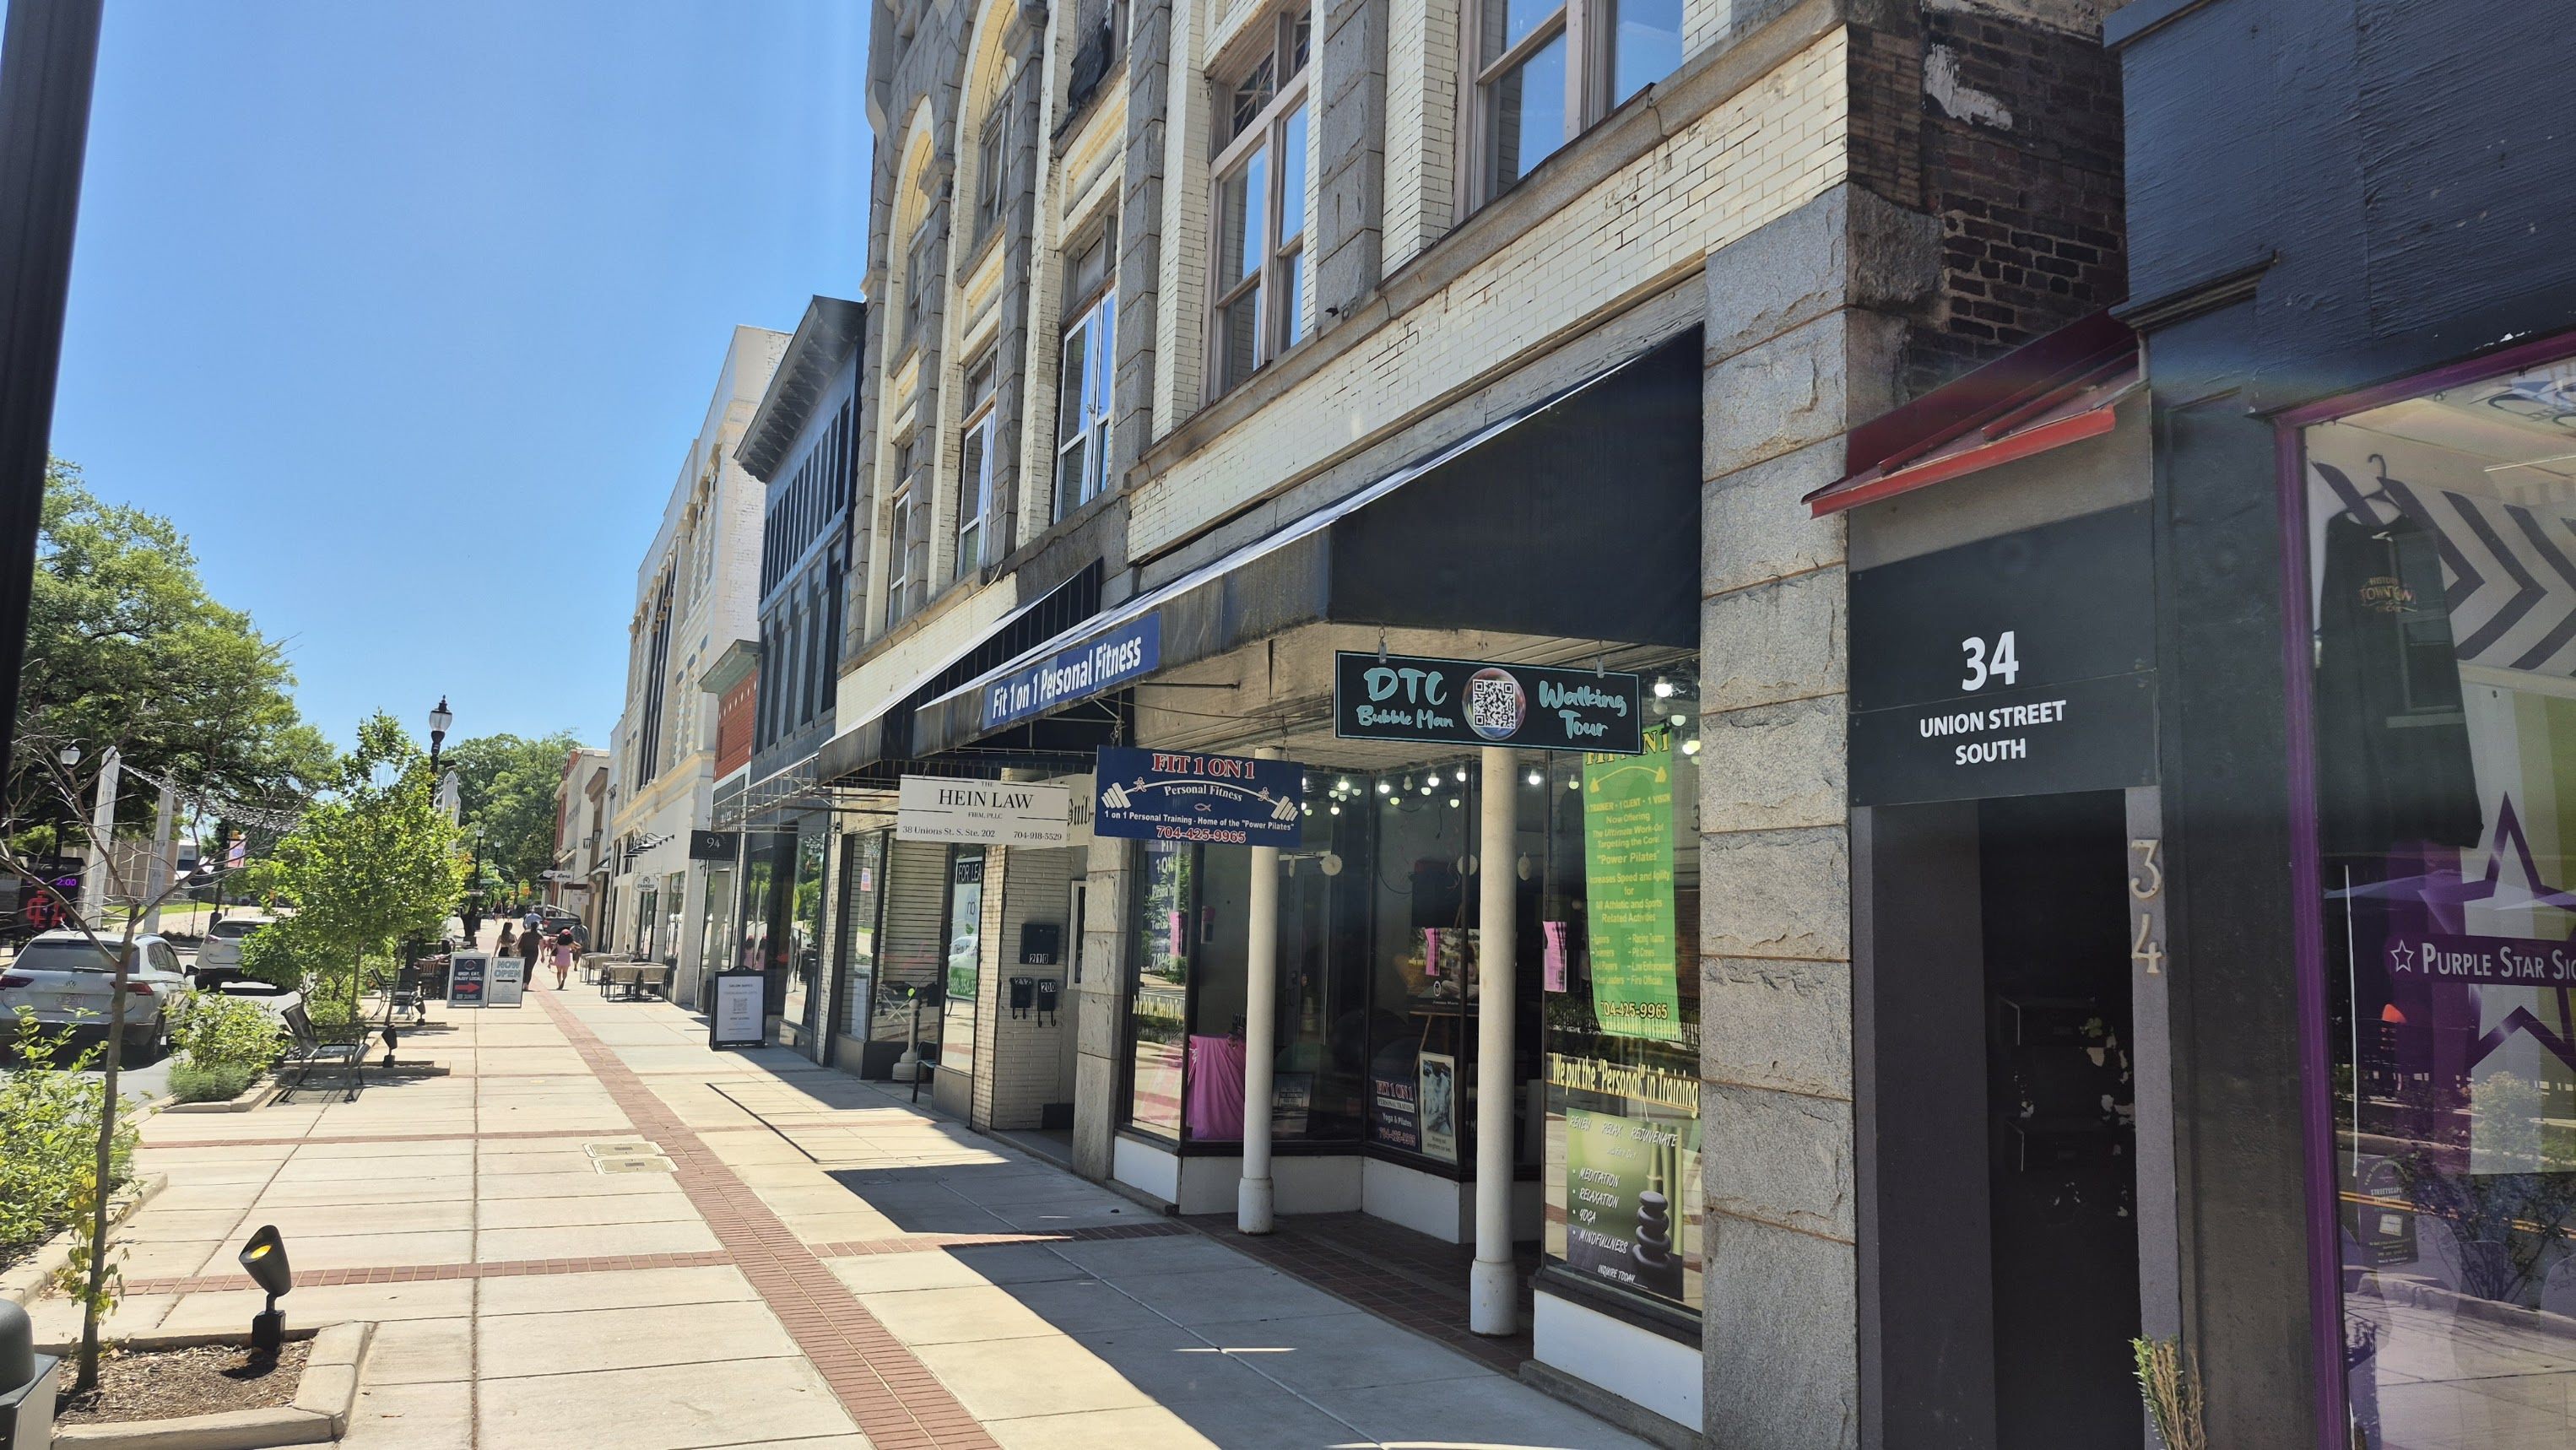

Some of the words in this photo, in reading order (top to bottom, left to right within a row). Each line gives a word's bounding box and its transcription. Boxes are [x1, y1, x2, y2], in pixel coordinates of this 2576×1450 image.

[1961, 630, 2020, 691] 34
[993, 685, 1008, 718] Fit
[1009, 683, 1015, 713] 1
[1016, 684, 1029, 711] on
[1033, 674, 1038, 705] 1
[1041, 649, 1092, 702] Personal
[1096, 636, 1141, 682] Fitness
[1364, 668, 1448, 706] DTC
[1539, 680, 1627, 717] Walking
[1356, 705, 1413, 727] Bubble
[1416, 709, 1453, 729] Man
[1559, 710, 1609, 739] Tour
[1920, 711, 1984, 739] UNION
[1988, 700, 2067, 730] STREET
[1955, 738, 2027, 766] SOUTH
[1151, 753, 1190, 774] FIT
[1193, 757, 1204, 776] 1
[1208, 759, 1242, 778] ON
[1245, 761, 1255, 779] 1
[939, 788, 986, 807] HEIN
[991, 792, 1034, 809] LAW
[1164, 785, 1206, 796] Personal
[1210, 786, 1242, 802] Fitness
[1129, 812, 1161, 821] Personal
[1163, 814, 1192, 825] Training
[1198, 817, 1217, 825] Home
[1229, 819, 1240, 827] the
[1242, 820, 1266, 829] "Power
[1268, 822, 1294, 831] Pilates"
[915, 826, 942, 835] Unions
[1014, 831, 1062, 840] 704-918-5529
[1156, 825, 1246, 843] 704-425-9965
[958, 863, 969, 881] FOR
[971, 863, 981, 880] LEA
[1617, 873, 1637, 884] Speed
[1630, 900, 1643, 908] and
[2130, 838, 2165, 974] 34
[1601, 913, 1626, 923] Related
[497, 960, 521, 969] NOW
[1029, 954, 1048, 964] 210
[2422, 942, 2492, 976] PURPLE
[2499, 946, 2545, 978] STAR
[1042, 982, 1055, 993] 200
[1600, 1000, 1668, 1019] 04-425-9965
[1553, 1052, 1565, 1085] We
[1566, 1059, 1581, 1096] put
[1582, 1055, 1596, 1090] the
[1647, 1064, 1656, 1101] in
[1659, 1068, 1699, 1119] Training
[1382, 1112, 1394, 1124] Yoga
[1569, 1115, 1592, 1132] RENEW
[1601, 1123, 1623, 1137] RELAX
[1630, 1127, 1678, 1147] REJUVENATE
[1578, 1167, 1621, 1188] MEDITATION
[1578, 1188, 1619, 1209] RELAXATION
[1579, 1209, 1596, 1225] YOGA
[1578, 1229, 1629, 1254] MINDFULLNESS
